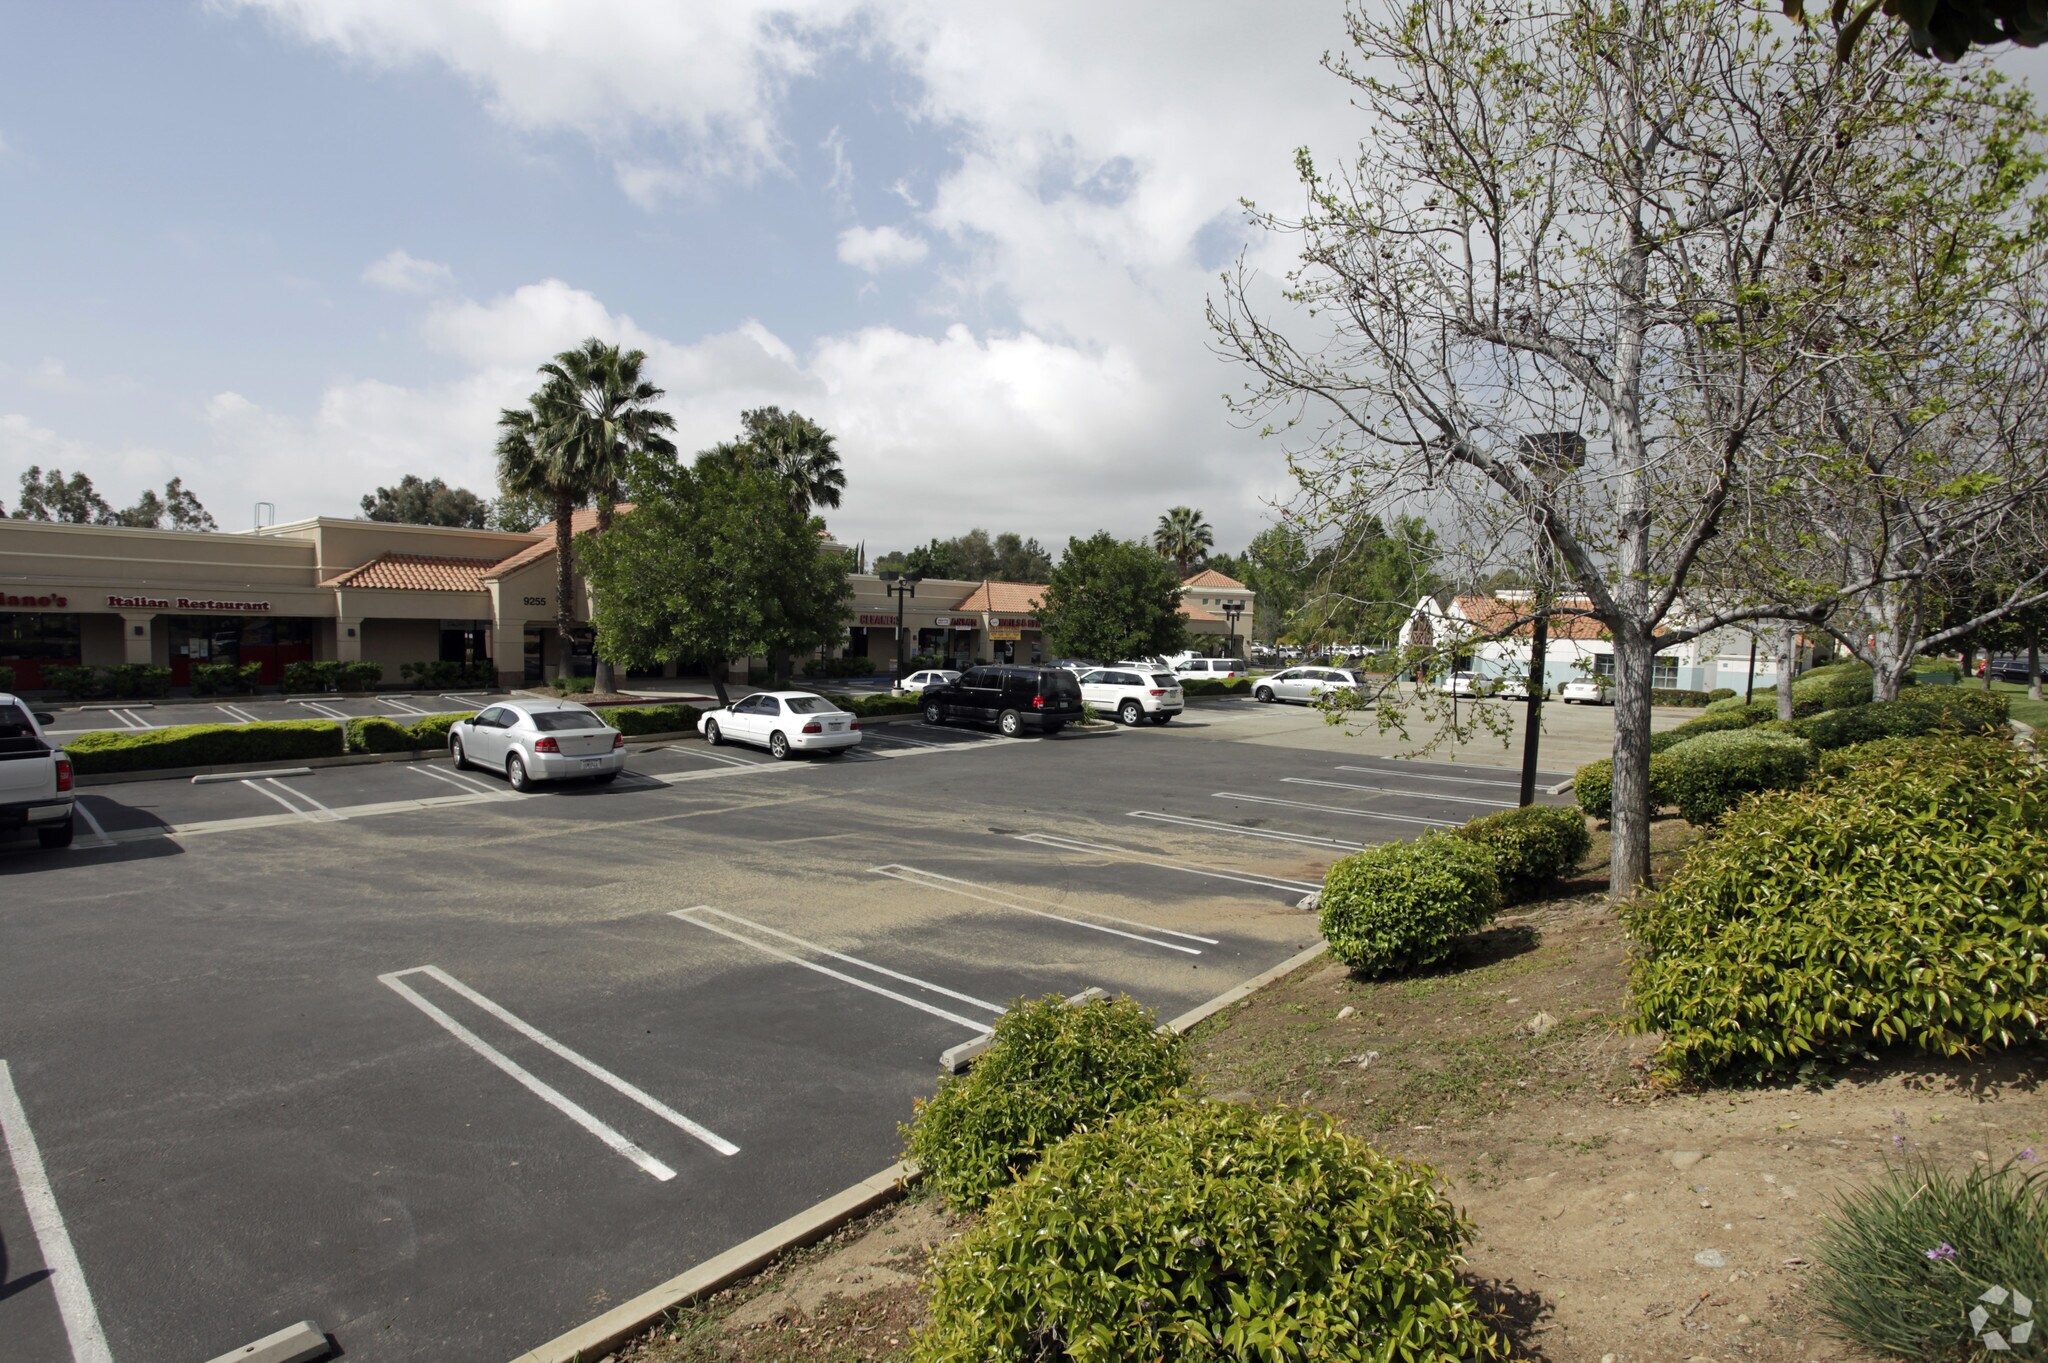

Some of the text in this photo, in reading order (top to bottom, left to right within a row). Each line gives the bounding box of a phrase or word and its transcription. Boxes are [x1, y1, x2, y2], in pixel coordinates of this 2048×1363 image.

[107, 596, 270, 610] Italian Restaurant
[523, 597, 546, 606] 9255
